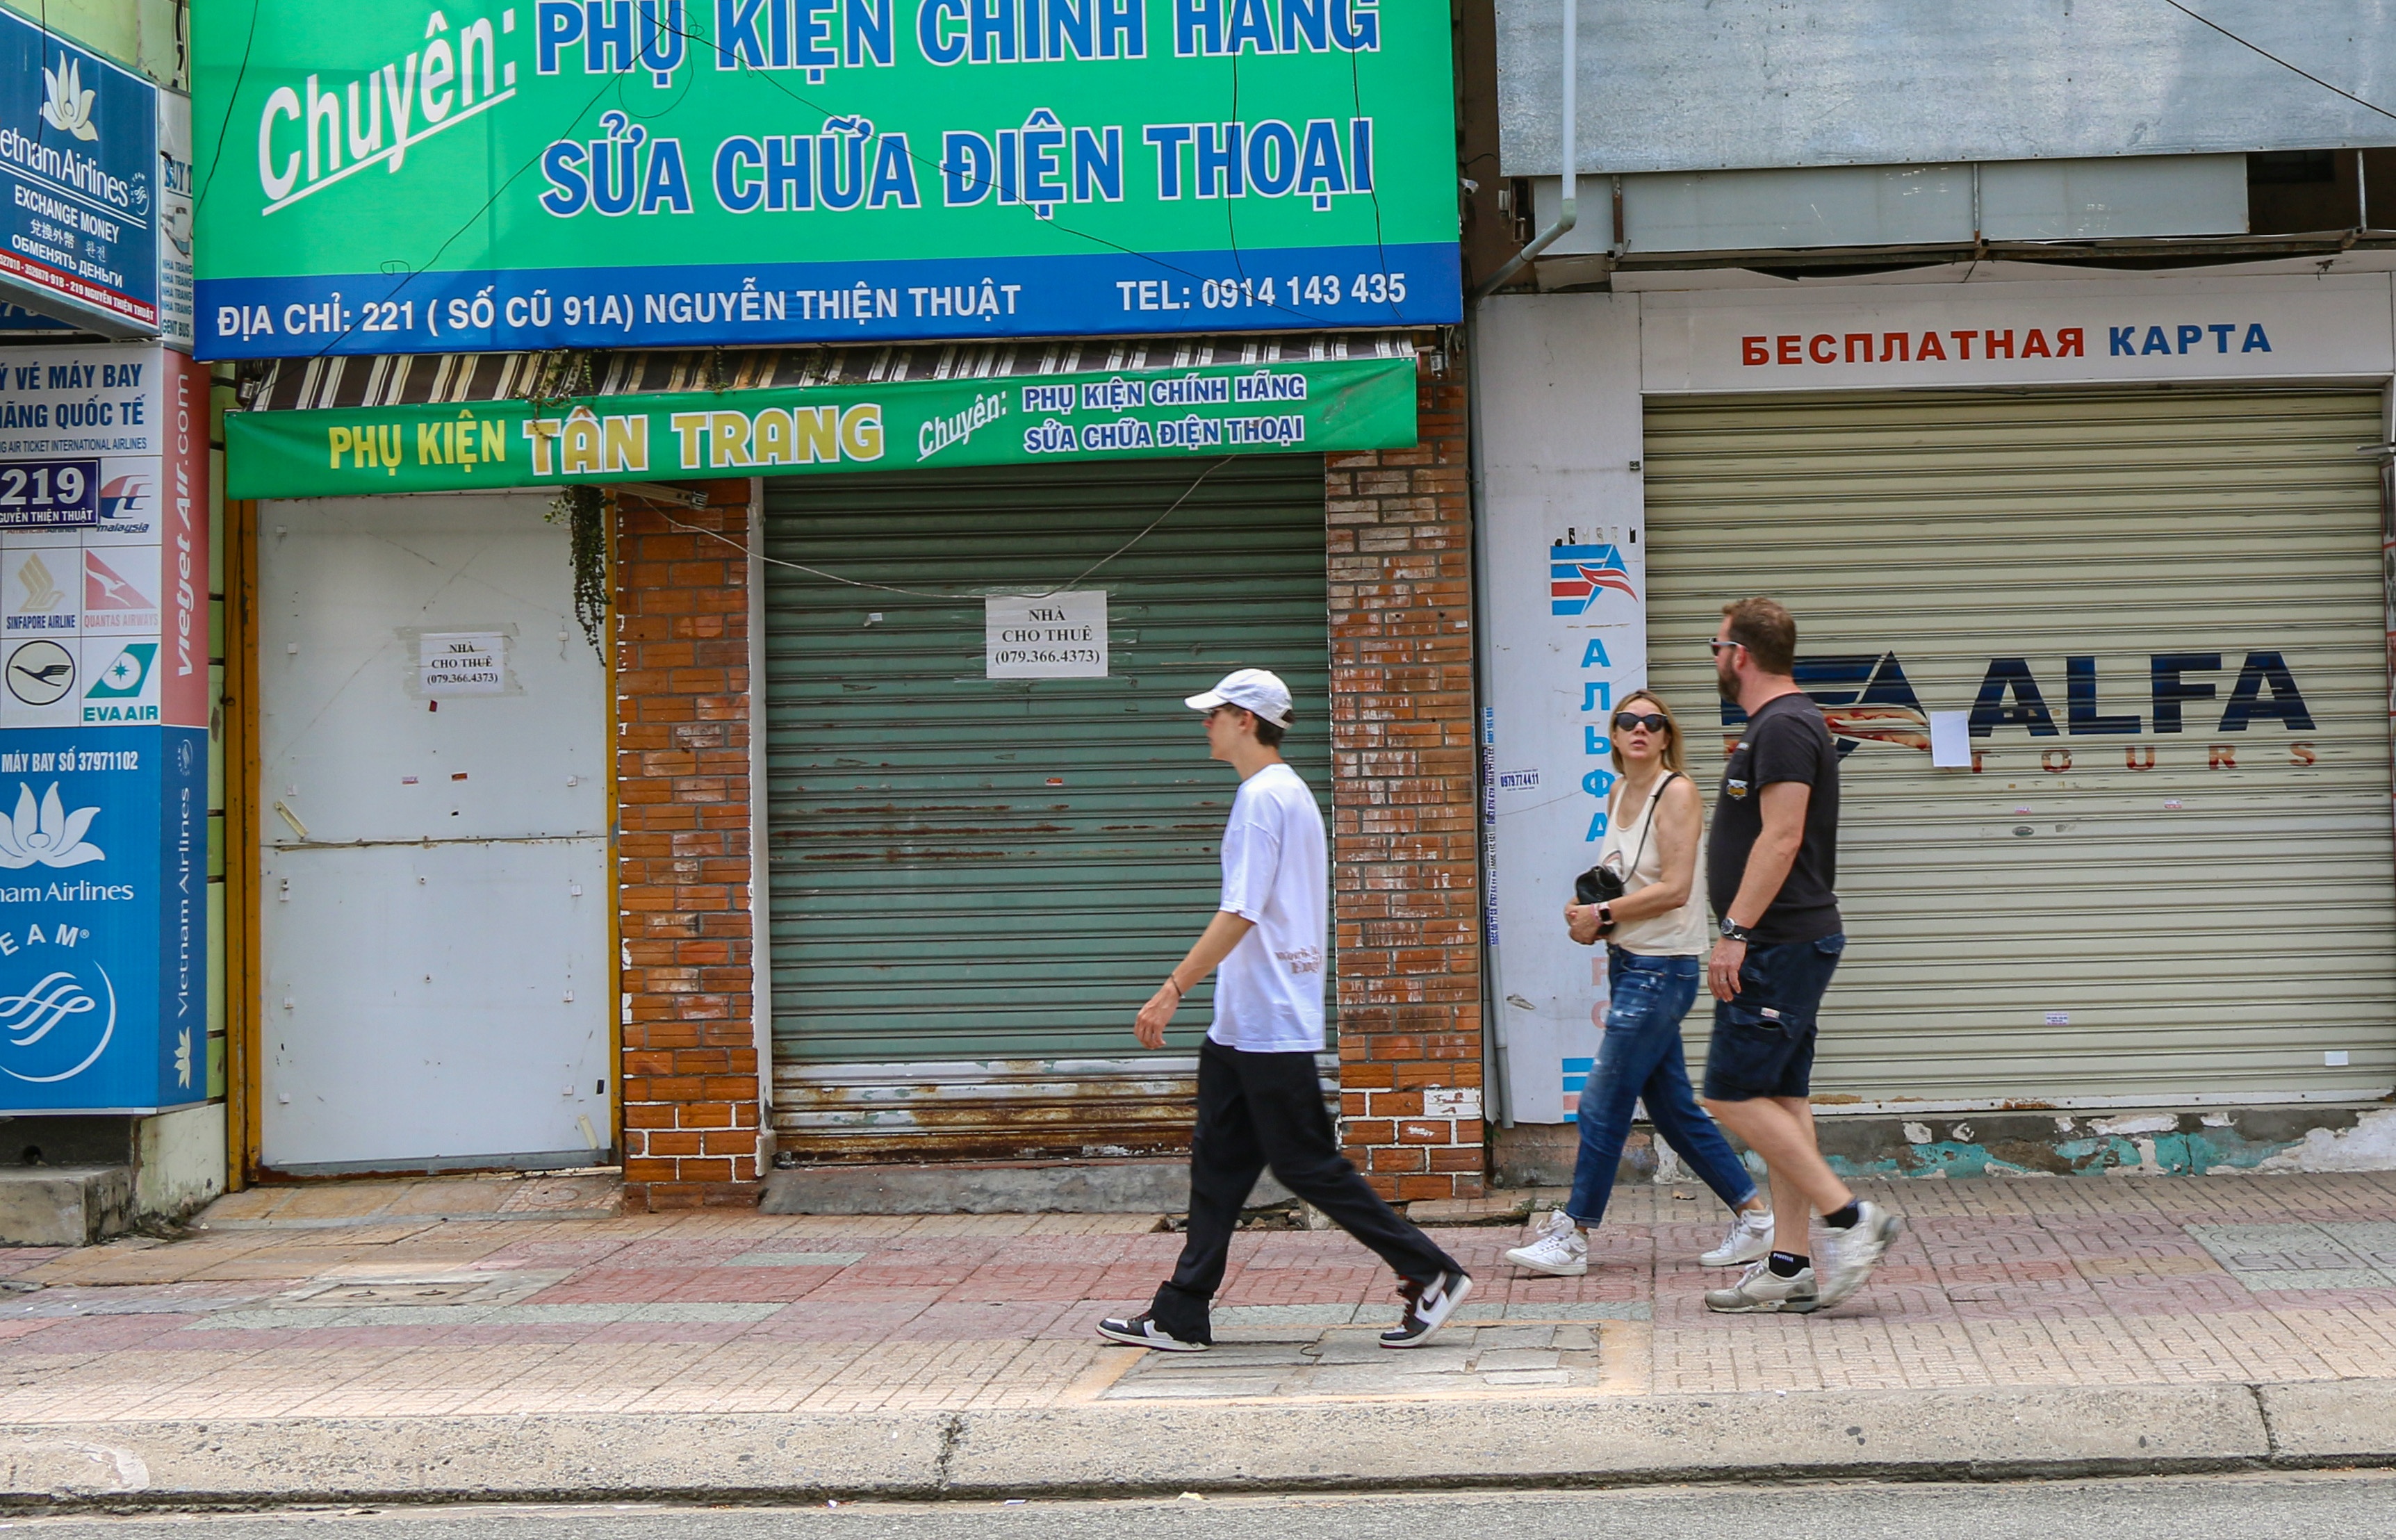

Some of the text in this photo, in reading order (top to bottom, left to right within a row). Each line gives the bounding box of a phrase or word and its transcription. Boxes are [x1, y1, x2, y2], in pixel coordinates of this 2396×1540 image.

[536, 0, 687, 88] PHỤ
[259, 8, 517, 202] Chuyên:
[61, 149, 129, 207] Airlines
[539, 107, 1374, 220] SỬA CHỮA ĐIỆN THOẠI
[15, 184, 120, 243] EXCHANGE MONEY
[12, 234, 123, 288] ОБМЕНЯТЬ ДЕНЬГИ
[217, 306, 274, 341] ĐỊA
[284, 292, 352, 334] CHỈ:
[362, 302, 414, 333] 221
[448, 285, 494, 330] SỐ
[506, 289, 550, 328] CŨ
[564, 294, 634, 331] 91A)
[644, 276, 785, 324] NGUYỄN
[797, 281, 898, 325] THIỆN
[909, 277, 1021, 322] THUẬT
[1117, 273, 1407, 311] TEL: 0914 143 435
[1741, 323, 2272, 366] БЕСПЛАТНАЯ КАРТА
[15, 361, 40, 391] VÉ
[49, 360, 96, 389] MÁY
[103, 363, 142, 387] BAY
[1022, 370, 1308, 415] PHỤ KIỆN CHÍNH HÃNG
[0, 393, 146, 429] ÃNG QUỐC TẾ
[917, 390, 1007, 457] Chuyên:
[9, 441, 22, 452] AIR
[23, 440, 49, 452] TICKET
[51, 438, 110, 451] INTERNATIONAL
[113, 437, 147, 450] AIRLINES
[329, 403, 884, 477] PHỤ KIỆN TÂN TRANG
[1023, 413, 1304, 454] SỬA CHỮA ĐIỆN THOẠI
[1, 467, 84, 505] 219
[30, 508, 60, 523] THIỆN
[61, 507, 93, 523] THUẬT
[97, 523, 149, 533] malaysia
[48, 615, 76, 628] AIRLINE
[85, 614, 158, 628] QUANTAS AIRWAYS
[1029, 606, 1065, 621] NHÀ
[450, 641, 475, 653] NHÀ
[1002, 625, 1092, 642] CHO THUÊ
[432, 655, 493, 669] CHO THUÊ
[995, 650, 1100, 666] (079.366.4373)
[427, 673, 498, 685] (079.366.4373)
[1968, 650, 2317, 737] ALFA
[1, 745, 138, 773] MÁY BAY SỐ 37971102
[1971, 742, 2317, 773] TOURS
[179, 787, 190, 895] Airlines
[44, 880, 134, 902] Airlines
[178, 899, 190, 1018] Vietnam
